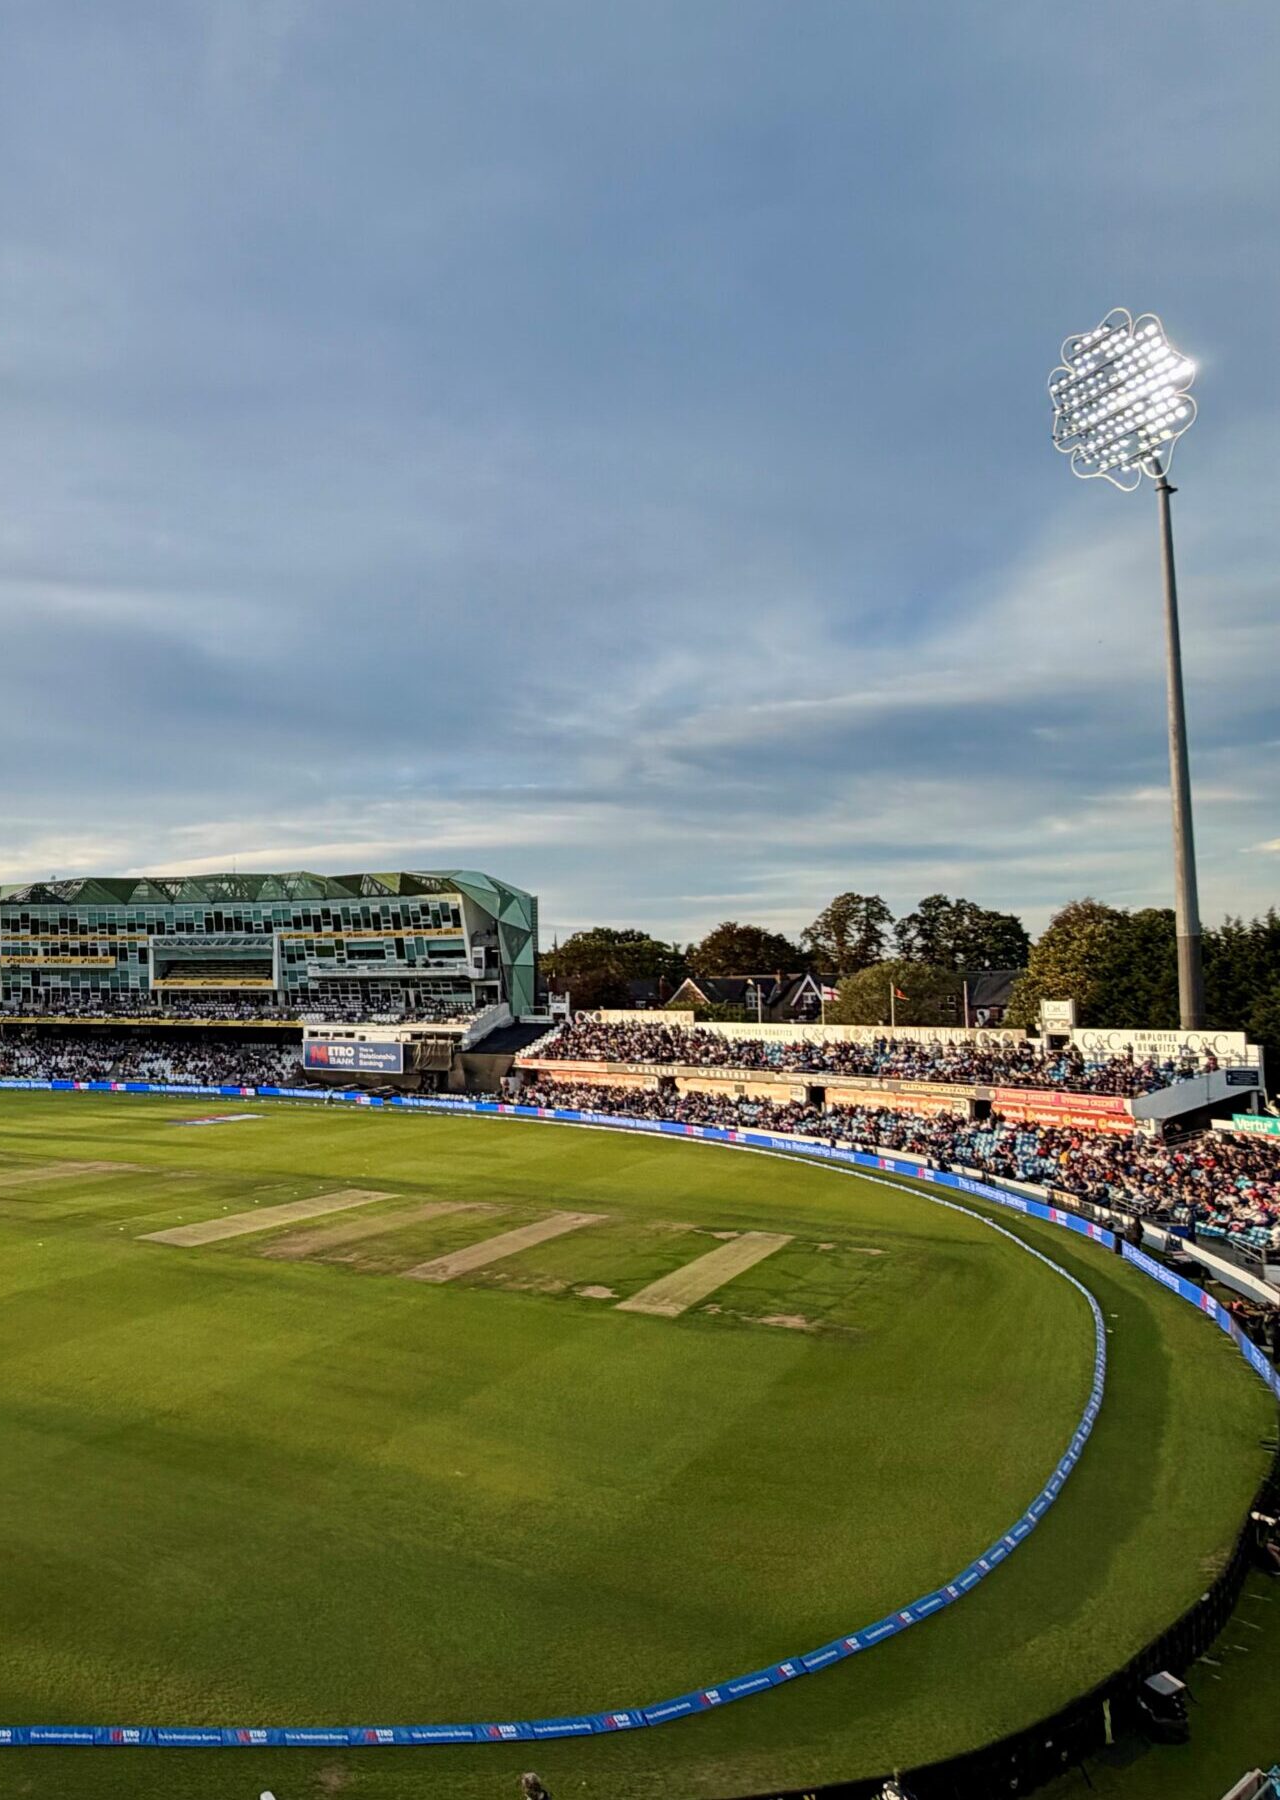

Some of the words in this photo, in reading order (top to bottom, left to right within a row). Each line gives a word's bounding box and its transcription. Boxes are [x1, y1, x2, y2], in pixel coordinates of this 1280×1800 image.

[1134, 1032, 1177, 1042] EMPLOYEE
[1137, 1043, 1176, 1053] BENEFITS
[310, 1045, 355, 1064] METRO
[359, 1052, 396, 1061] Relationship
[329, 1057, 354, 1065] BANK
